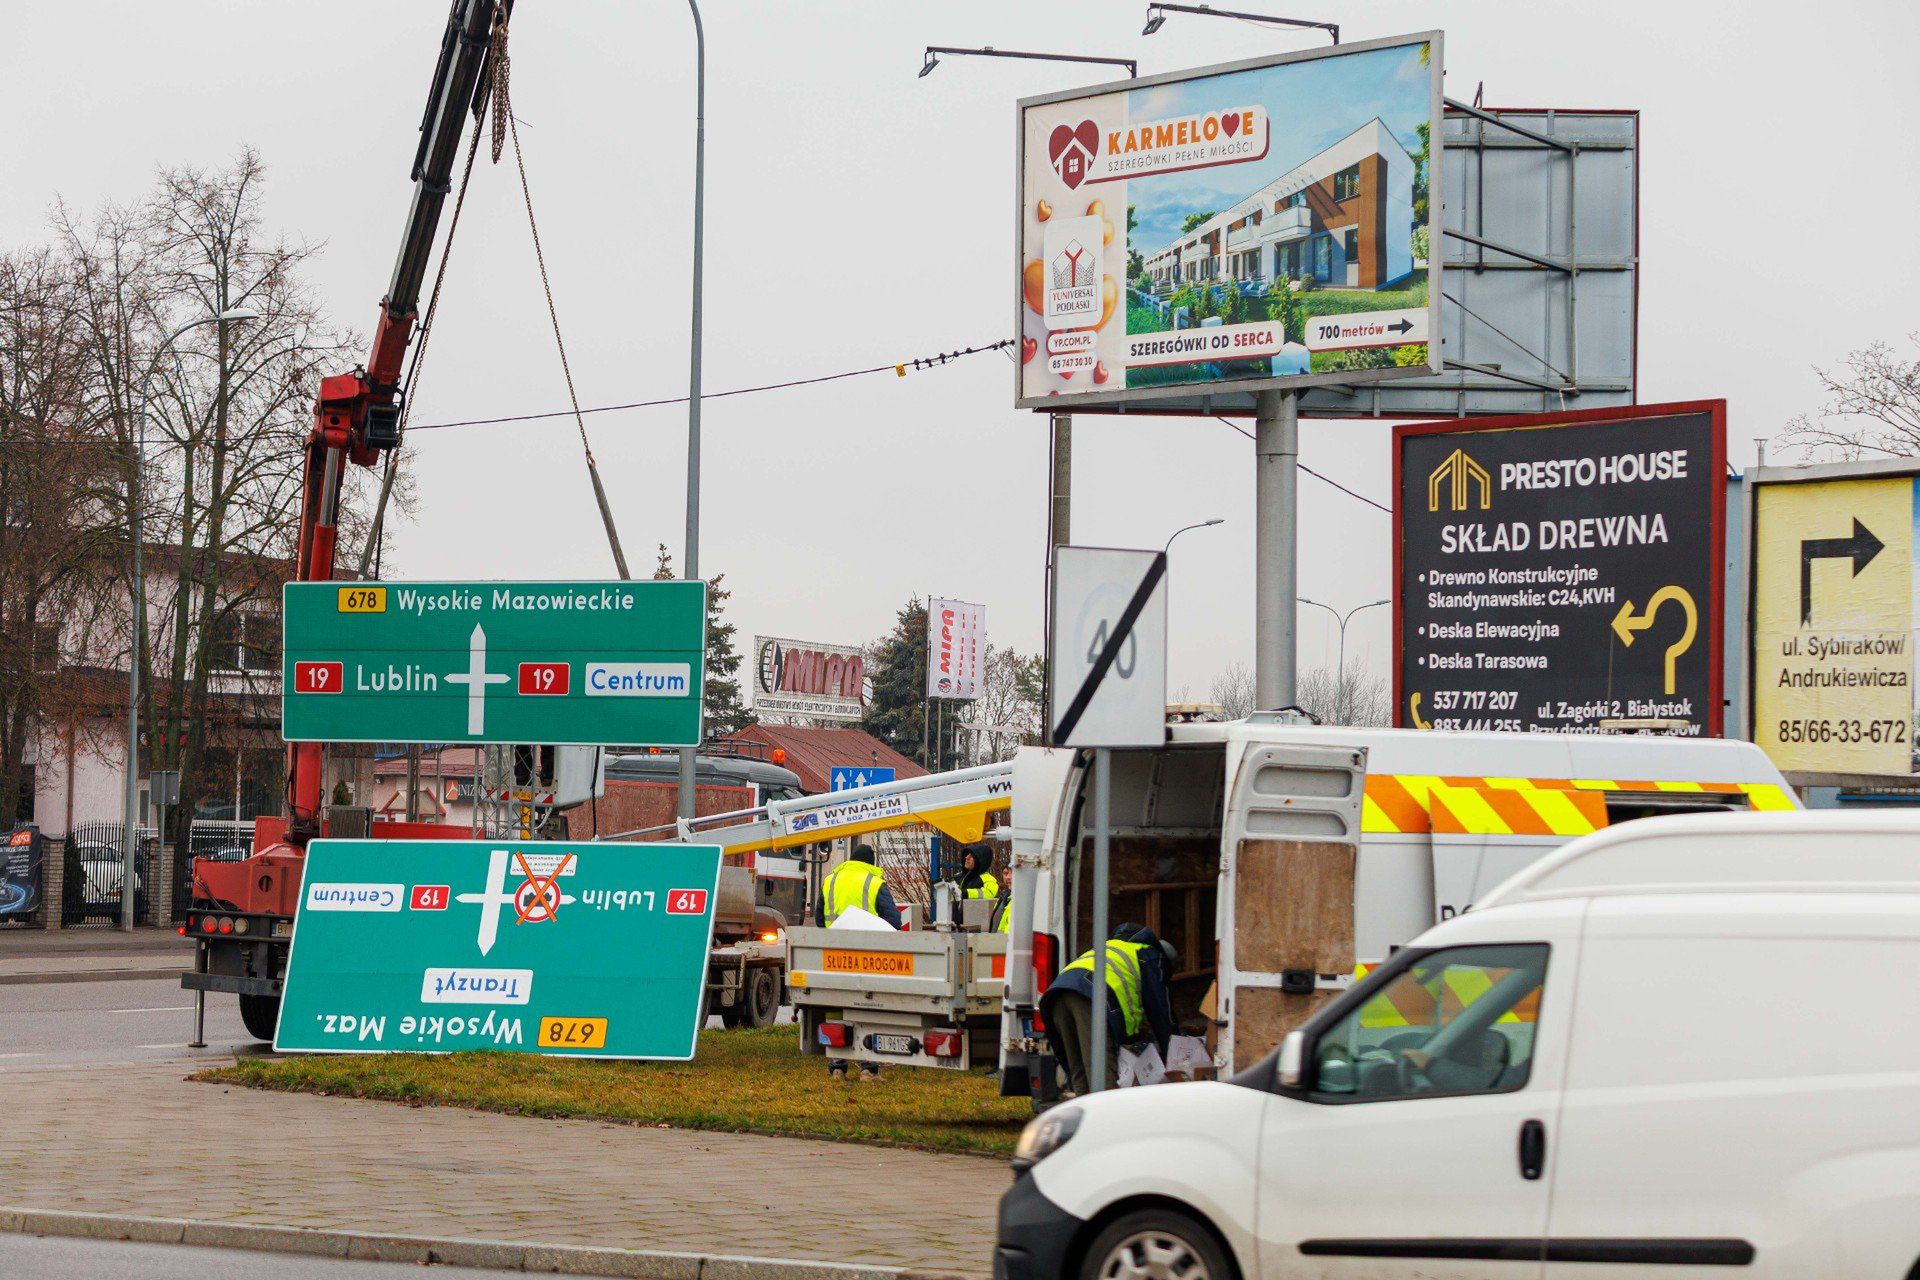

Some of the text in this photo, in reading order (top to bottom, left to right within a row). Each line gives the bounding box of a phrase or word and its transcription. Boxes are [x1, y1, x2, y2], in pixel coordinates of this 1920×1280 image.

[1108, 141, 1253, 172] SZEREGÓWKI PEŁNE MIŁOŚCI
[1052, 288, 1094, 300] YUNIVERSAL
[1056, 300, 1090, 312] PODLASKI
[1319, 322, 1384, 340] 700 metrów
[1130, 331, 1274, 357] SZEREGÓWKI OD SERCA
[1052, 360, 1061, 369] 85
[1075, 358, 1083, 367] 30
[1084, 357, 1093, 365] 30
[1500, 450, 1687, 490] PRESTO HOUSE
[1440, 513, 1669, 554] SKŁAD DREWNA
[1429, 563, 1598, 586] Drewno Konstrukcyjne
[347, 588, 635, 616] 678 Wysokie Mazowieckie
[1428, 587, 1615, 611] Skandynawskie: C24,KVH
[940, 609, 955, 674] MIPA
[1429, 620, 1560, 641] Deska Elewacyjna
[1782, 636, 1802, 657] ul.
[1429, 652, 1548, 669] Deska Tarasowa
[308, 665, 438, 691] 19 Lublin
[533, 668, 685, 691] 19 Centrum
[780, 648, 863, 697] MIPA
[1778, 666, 1908, 688] Andrukiewicza
[1433, 690, 1519, 710] 537 717 207
[1537, 698, 1693, 723] ul. Zagórki 2, Białystok
[1778, 719, 1907, 744] 85/66-33-672
[823, 798, 901, 819] WYNAJEM
[314, 888, 439, 907] 19 Centrum
[582, 888, 697, 912] 19 Lublin
[827, 952, 911, 972] SŁUŻBA DROGOWA
[435, 971, 519, 998] Tranzyt
[316, 1009, 595, 1044] 678 Wysokie Maz.
